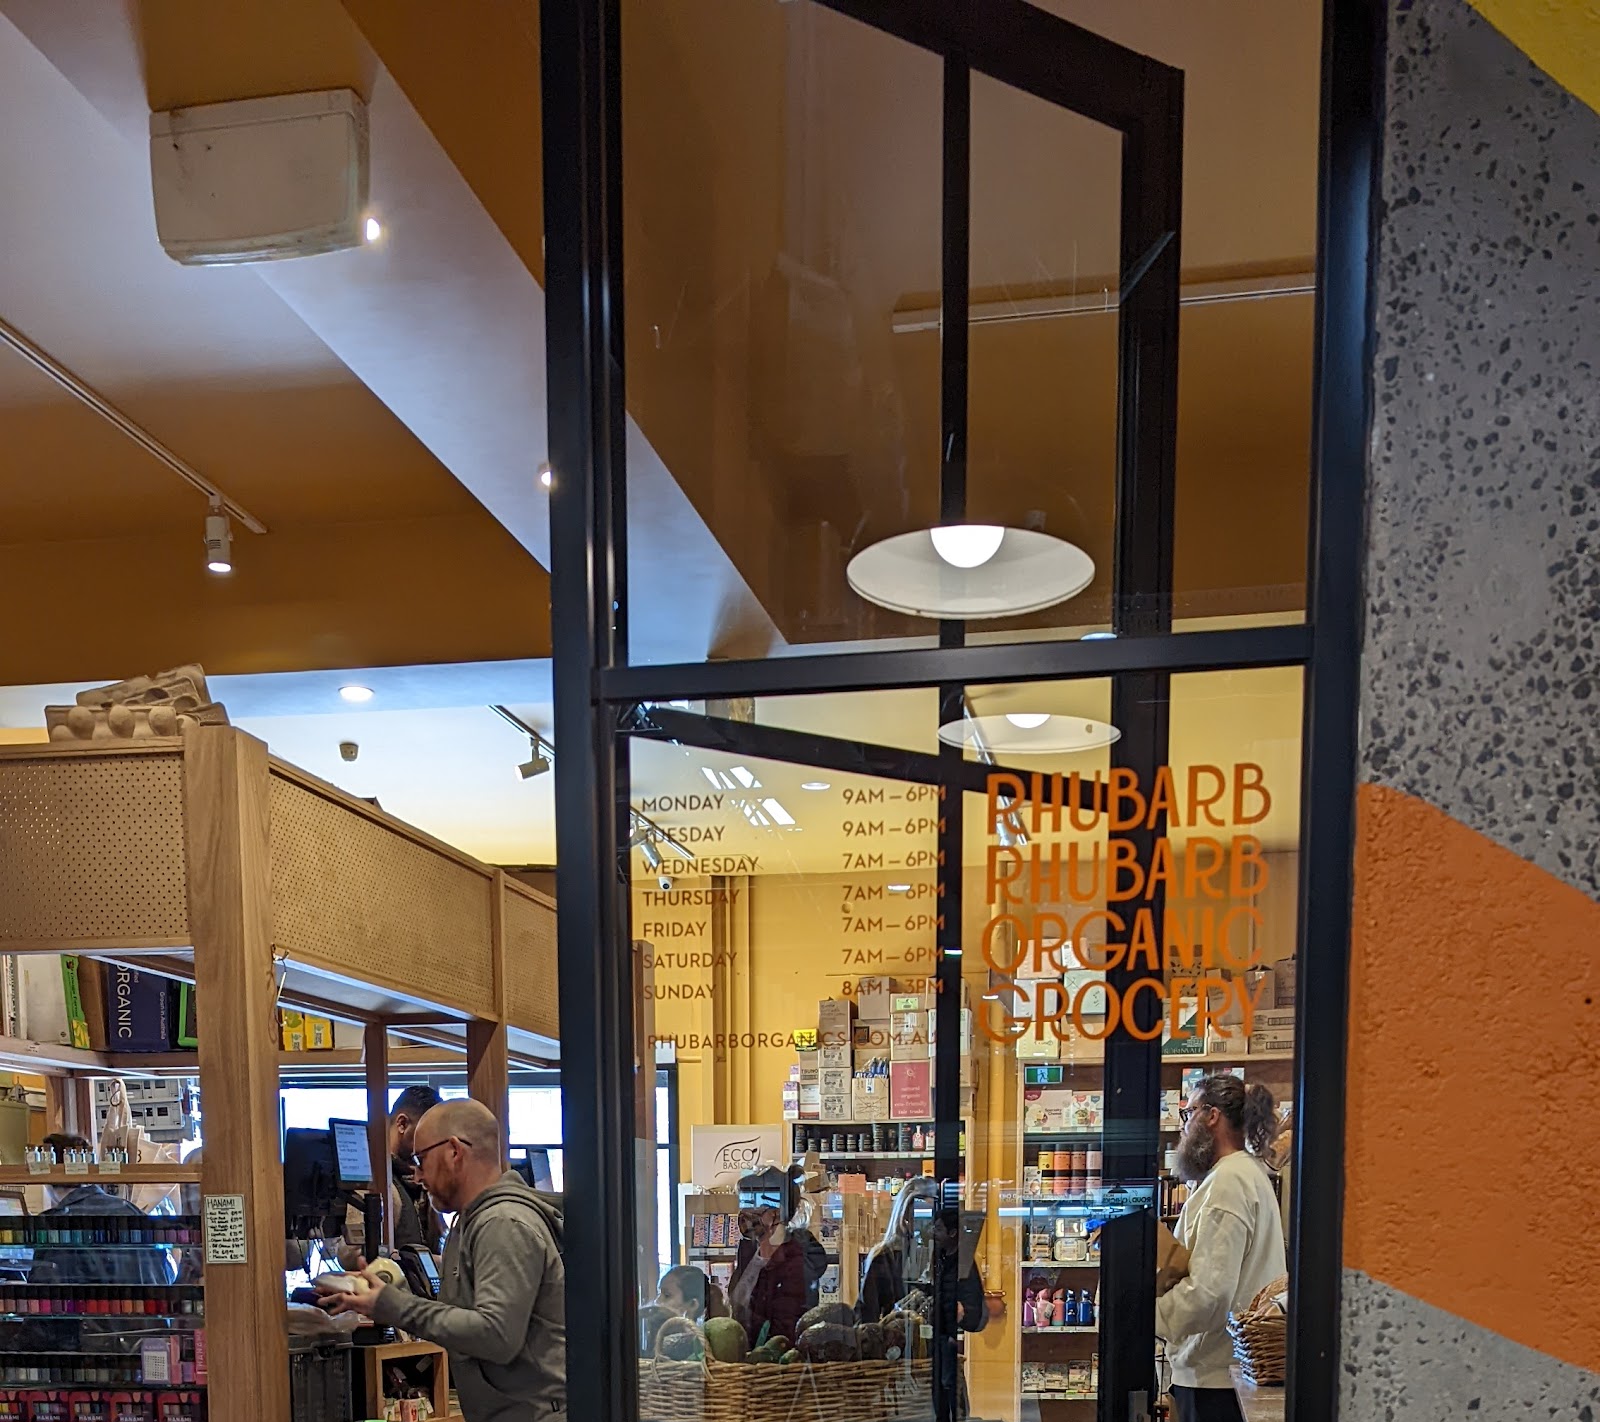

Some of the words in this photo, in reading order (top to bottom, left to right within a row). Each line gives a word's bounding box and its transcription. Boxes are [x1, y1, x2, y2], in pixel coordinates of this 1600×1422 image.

[642, 794, 725, 813] MONDAY
[842, 788, 884, 805] 9AM
[906, 785, 947, 802] 6PM
[986, 762, 1272, 835] RHUBARB
[842, 820, 884, 838] 9AM
[904, 817, 946, 835] 6PM
[642, 856, 760, 875] WEDNESDAY
[842, 852, 884, 869] 7AM
[905, 850, 946, 868] 6PM
[986, 834, 1270, 905] RHUBARB
[642, 889, 740, 908] THURSDAY
[842, 885, 884, 902] 7AM
[905, 883, 946, 899] 6PM
[642, 921, 707, 938] FRIDAY
[842, 916, 884, 933] 7AM
[905, 915, 945, 931] 6PM
[981, 906, 1265, 974] ORGANIC
[643, 952, 738, 969] SATURDAY
[842, 948, 884, 965] 7AM
[904, 946, 944, 963] 6PM
[643, 984, 717, 1000] SUNDAY
[842, 981, 883, 996] 8AM
[906, 978, 944, 994] 3PM
[978, 976, 1267, 1044] GROCERY
[723, 1148, 757, 1162] ECO
[723, 1162, 751, 1170] BASICS
